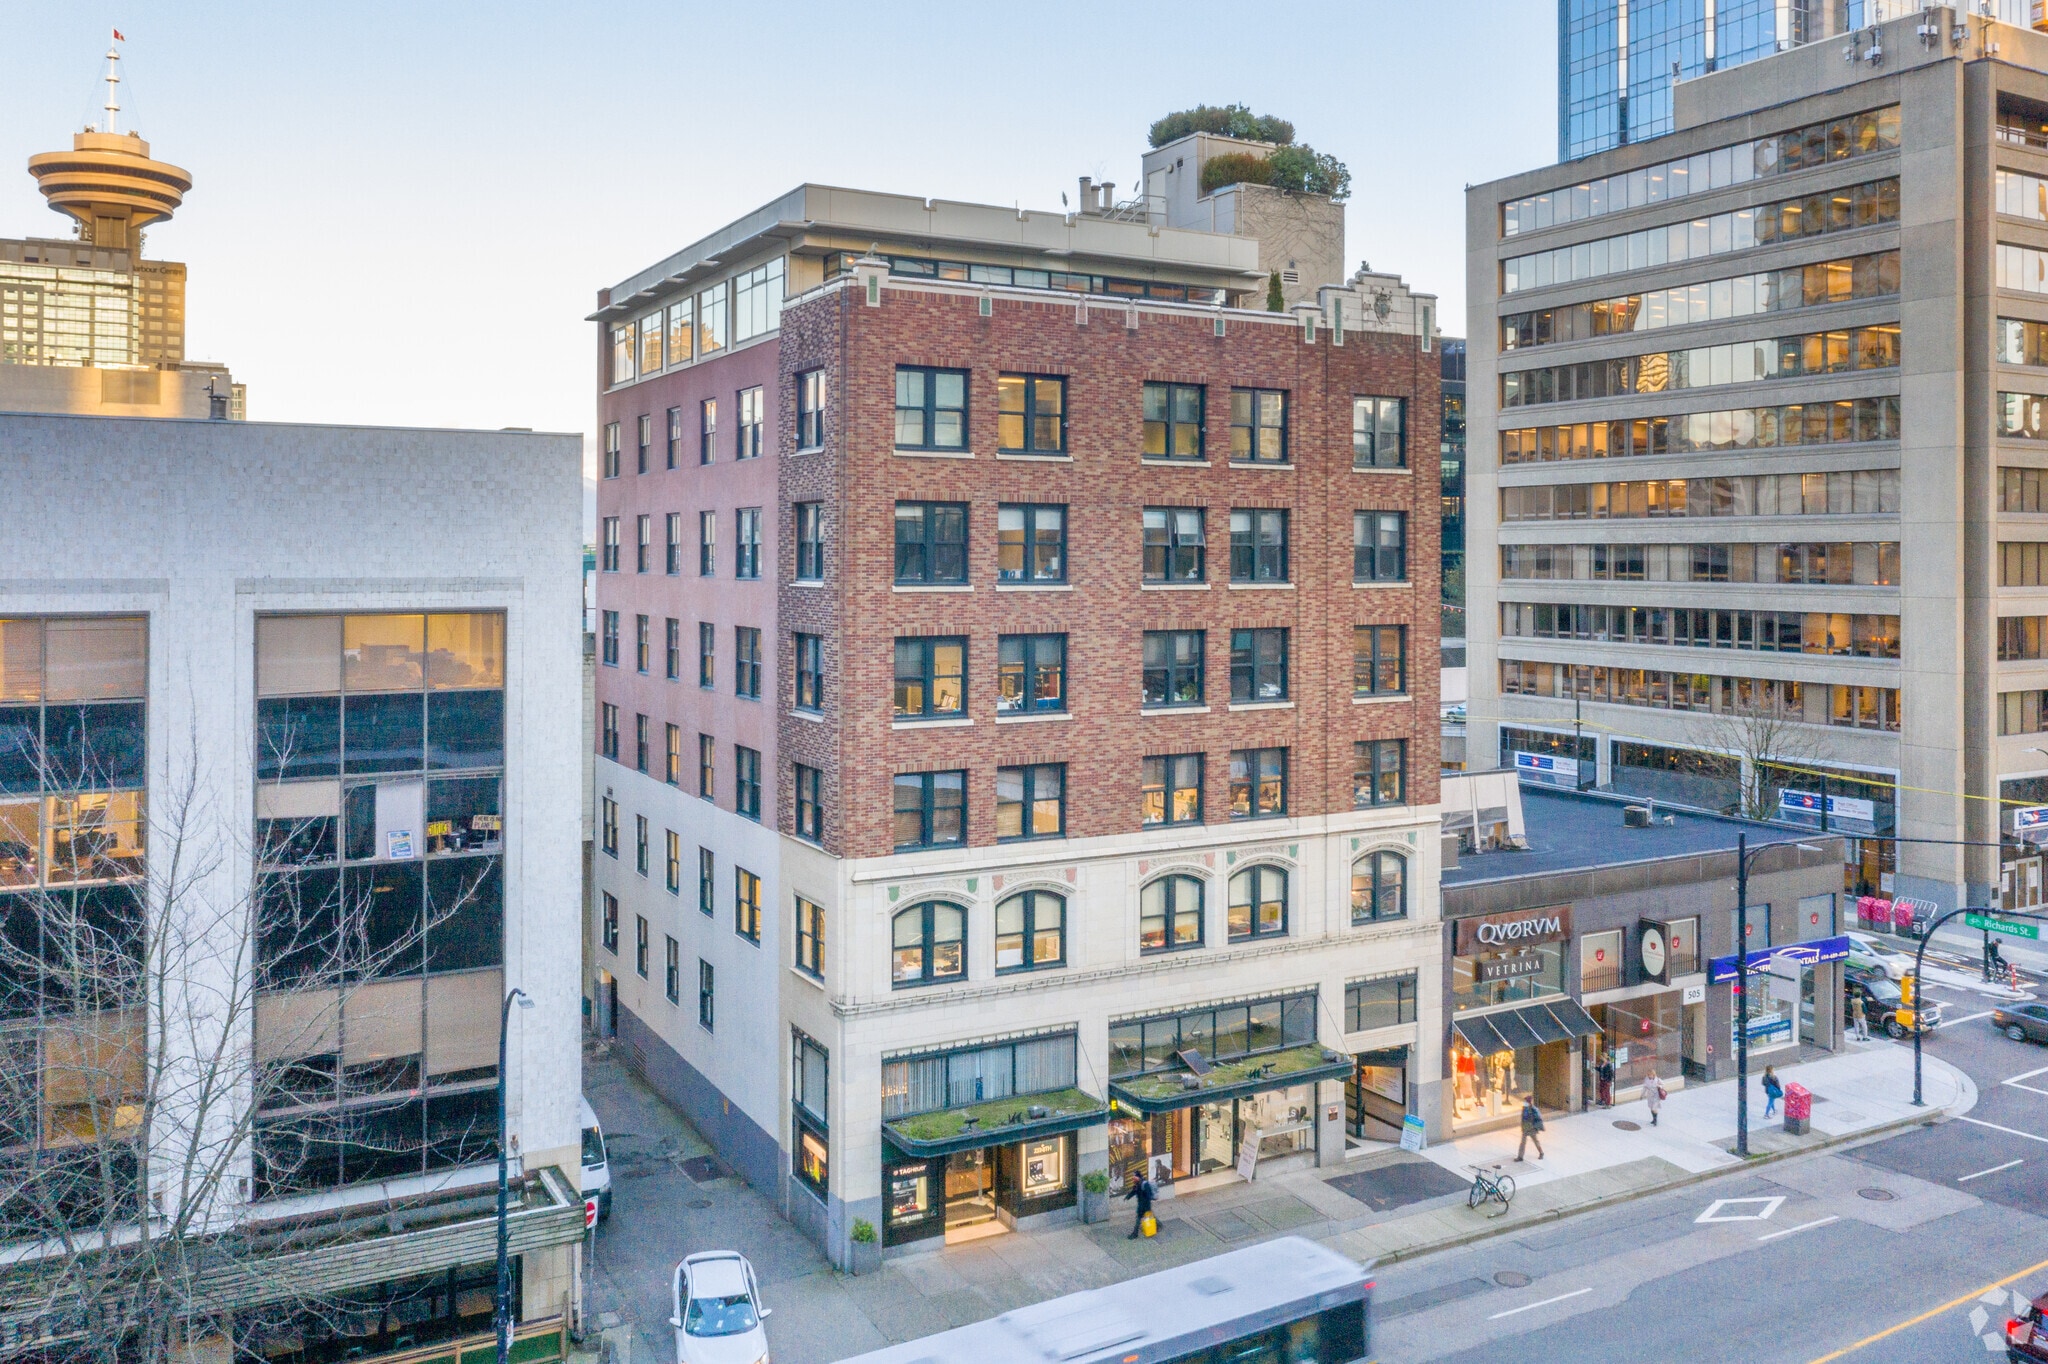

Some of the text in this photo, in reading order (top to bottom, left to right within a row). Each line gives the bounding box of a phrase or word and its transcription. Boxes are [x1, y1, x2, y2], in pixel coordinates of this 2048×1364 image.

[1984, 919, 2031, 936] Richards St.
[1487, 960, 1540, 977] VETRINA
[1688, 989, 1700, 999] 505
